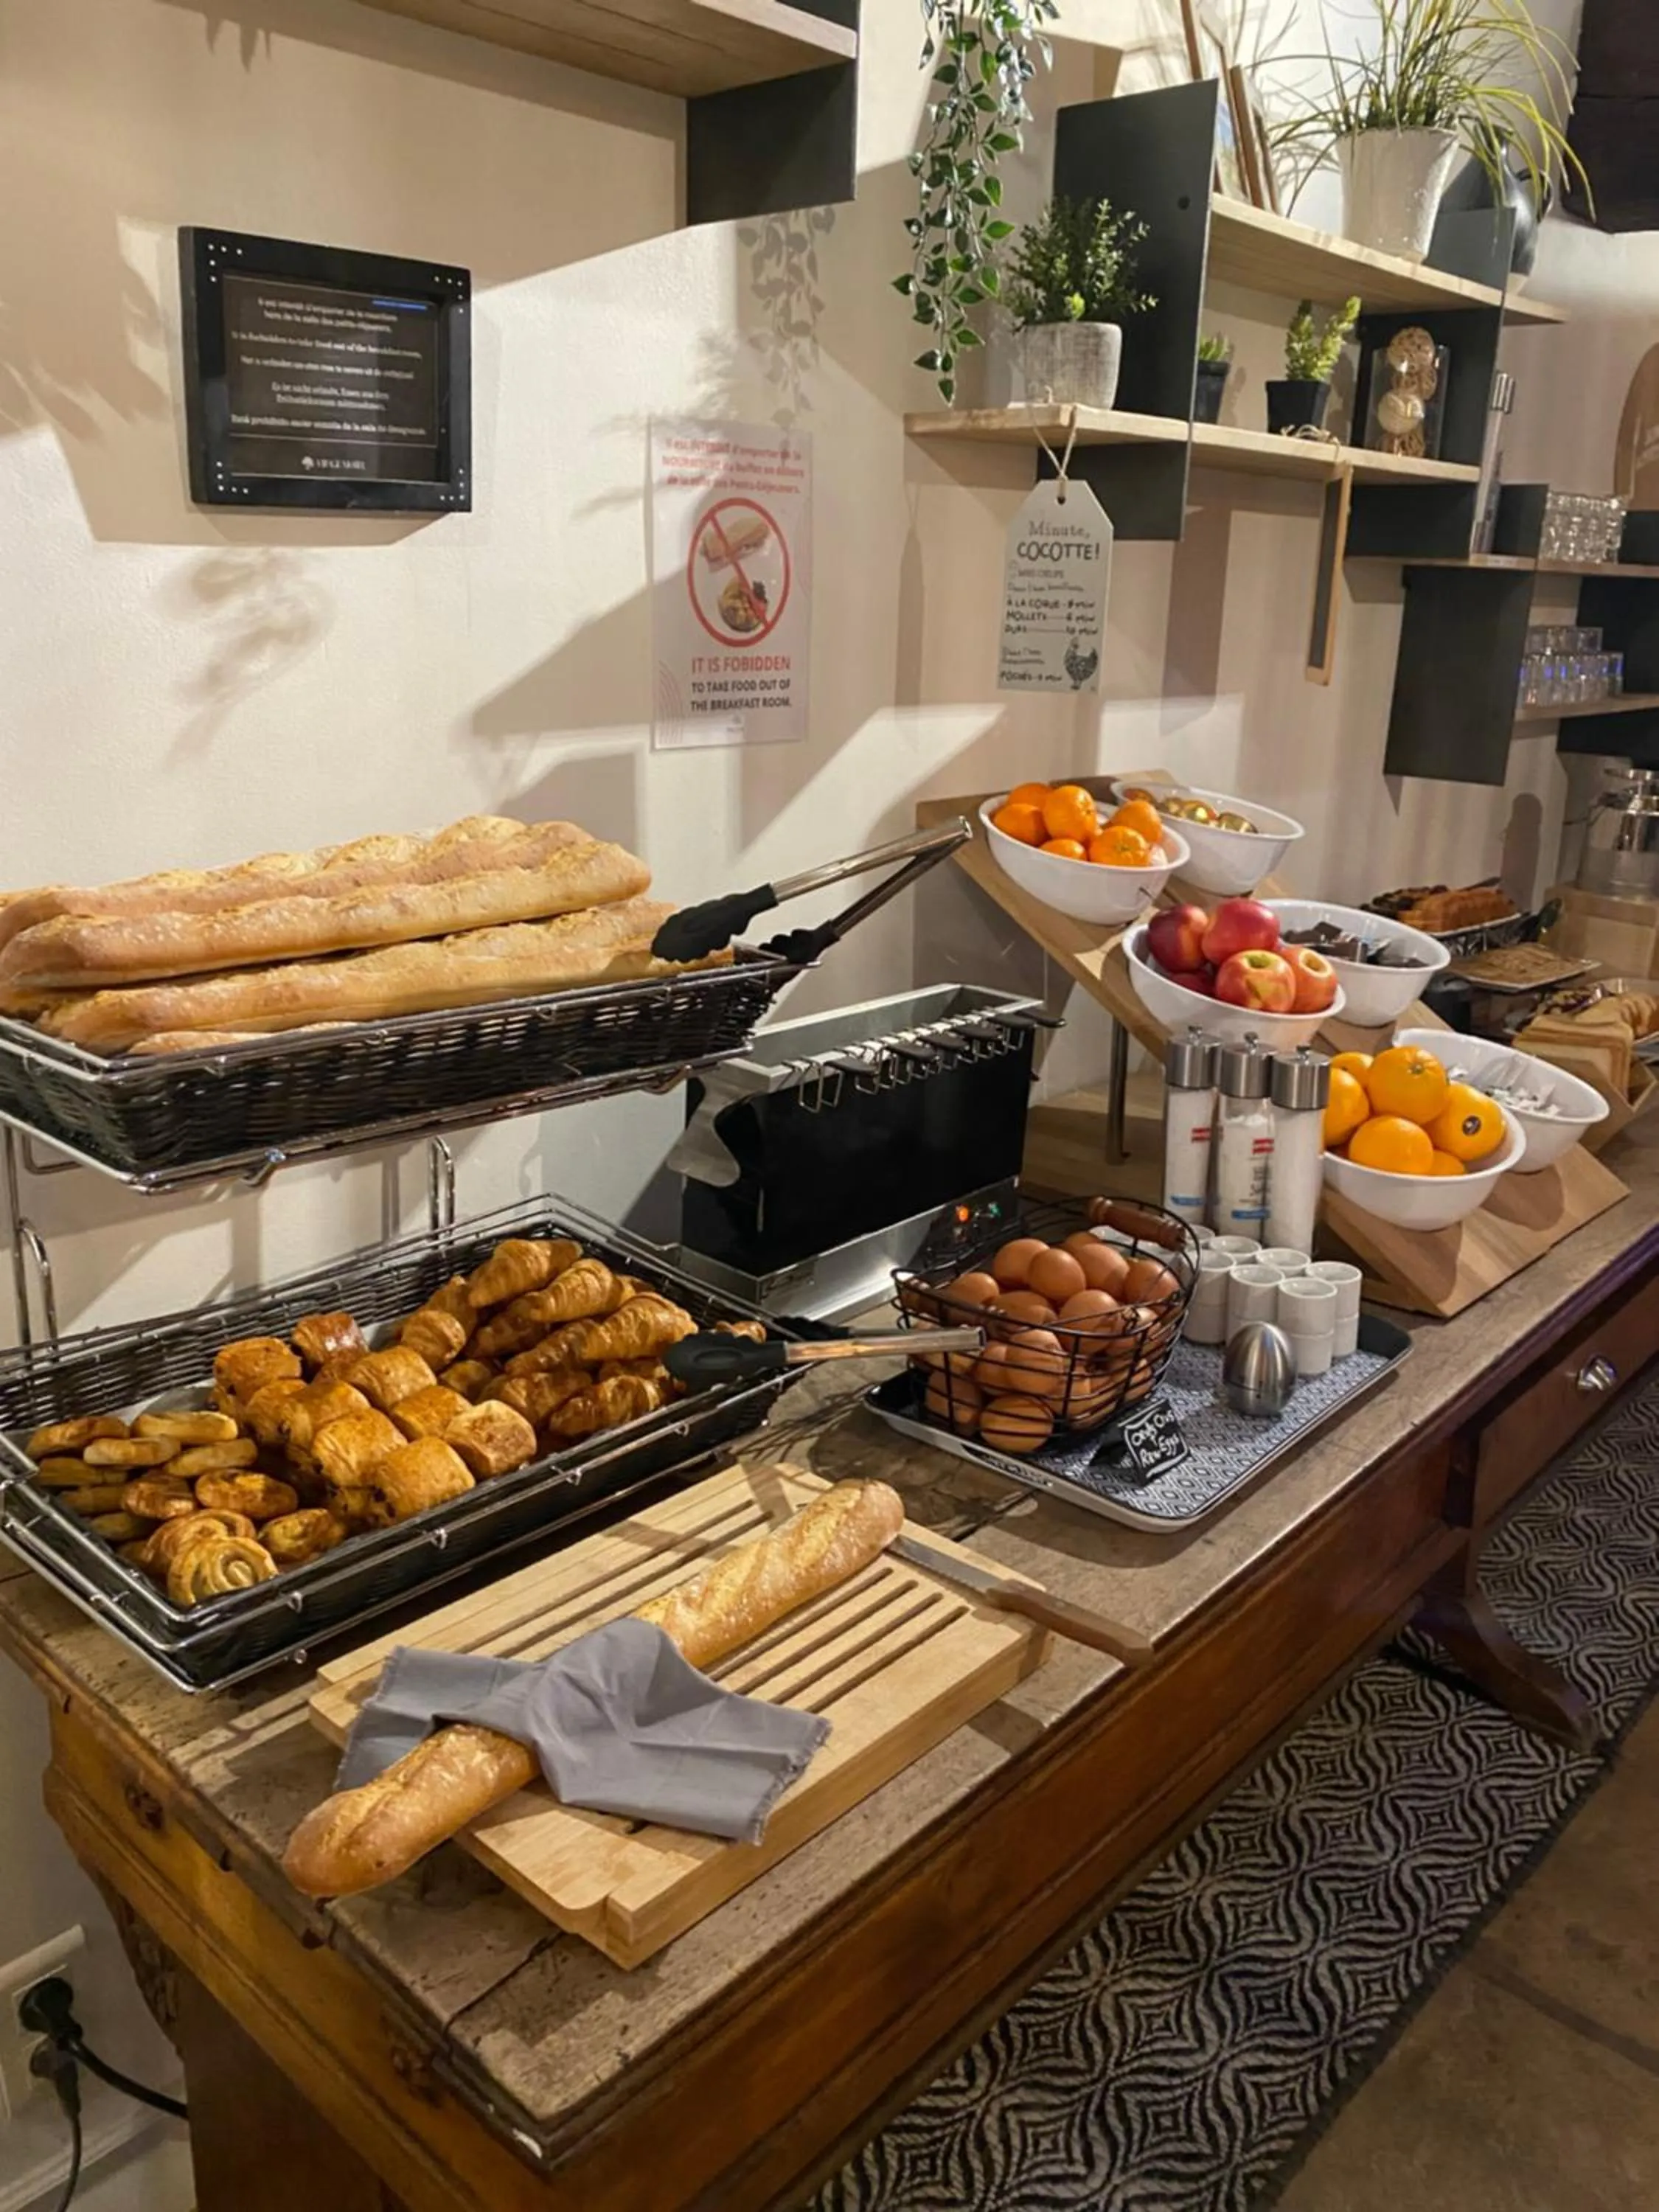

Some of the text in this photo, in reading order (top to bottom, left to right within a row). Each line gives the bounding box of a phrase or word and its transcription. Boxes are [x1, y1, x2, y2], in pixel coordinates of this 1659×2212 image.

[1017, 540, 1100, 562] COCOTTE!
[692, 655, 791, 673] IT IS FOBIDDEN
[692, 677, 791, 694] TO TAKE FOOD OUT OF
[691, 699, 708, 712] THE
[710, 697, 760, 711] BREAKFAST
